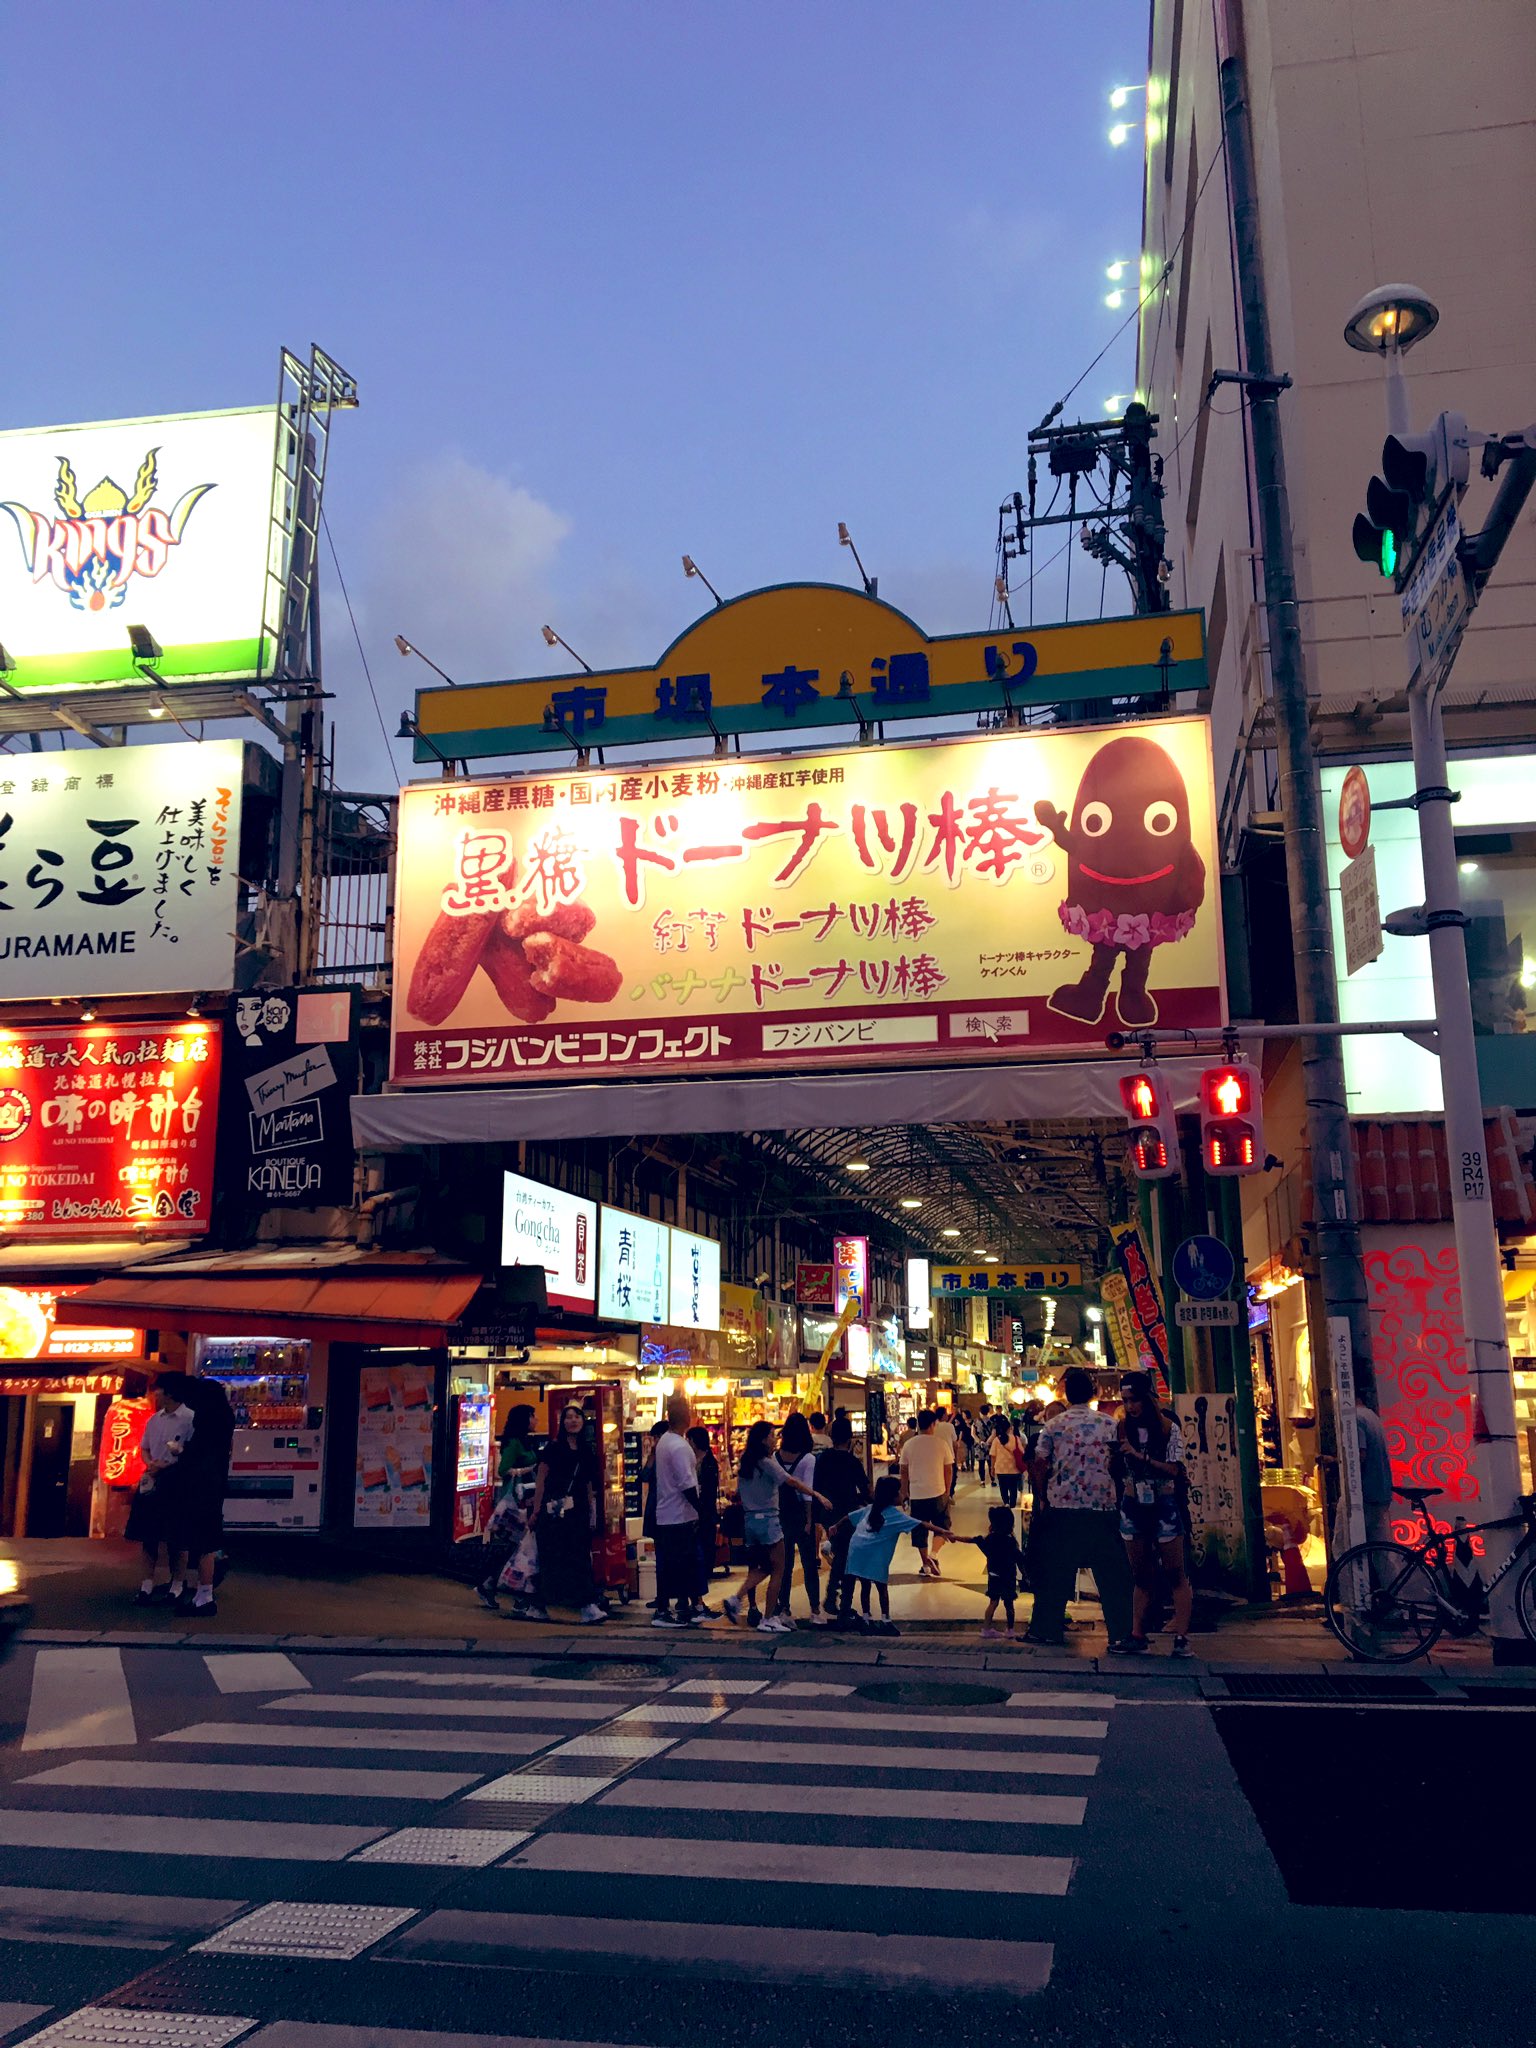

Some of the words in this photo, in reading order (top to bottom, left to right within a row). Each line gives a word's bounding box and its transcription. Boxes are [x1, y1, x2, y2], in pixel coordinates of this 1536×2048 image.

[552, 641, 1037, 735] 市場本通り
[0, 773, 114, 795] 登録商標
[208, 786, 233, 886] そら豆を
[180, 798, 208, 897] 美味しく
[150, 806, 182, 943] 仕上げました。
[979, 950, 1080, 964] ドーナツ棒キャラクター
[980, 966, 1027, 978] ケインくん
[772, 1021, 877, 1048] フジバンビ
[966, 1016, 1012, 1032] 検索
[445, 1025, 732, 1070] フジバンビコンフェクト
[41, 1086, 204, 1140] 味の時計台
[259, 1110, 314, 1146] Montana
[266, 1157, 306, 1167] BOUTIQUE
[1461, 1152, 1481, 1166] 39
[29, 1172, 95, 1187] TOKEIDAI
[1463, 1167, 1484, 1182] R4
[1464, 1183, 1484, 1196] P17
[514, 1207, 543, 1248] Gong
[543, 1217, 560, 1246] cha
[941, 1271, 1070, 1291] 市場本通り
